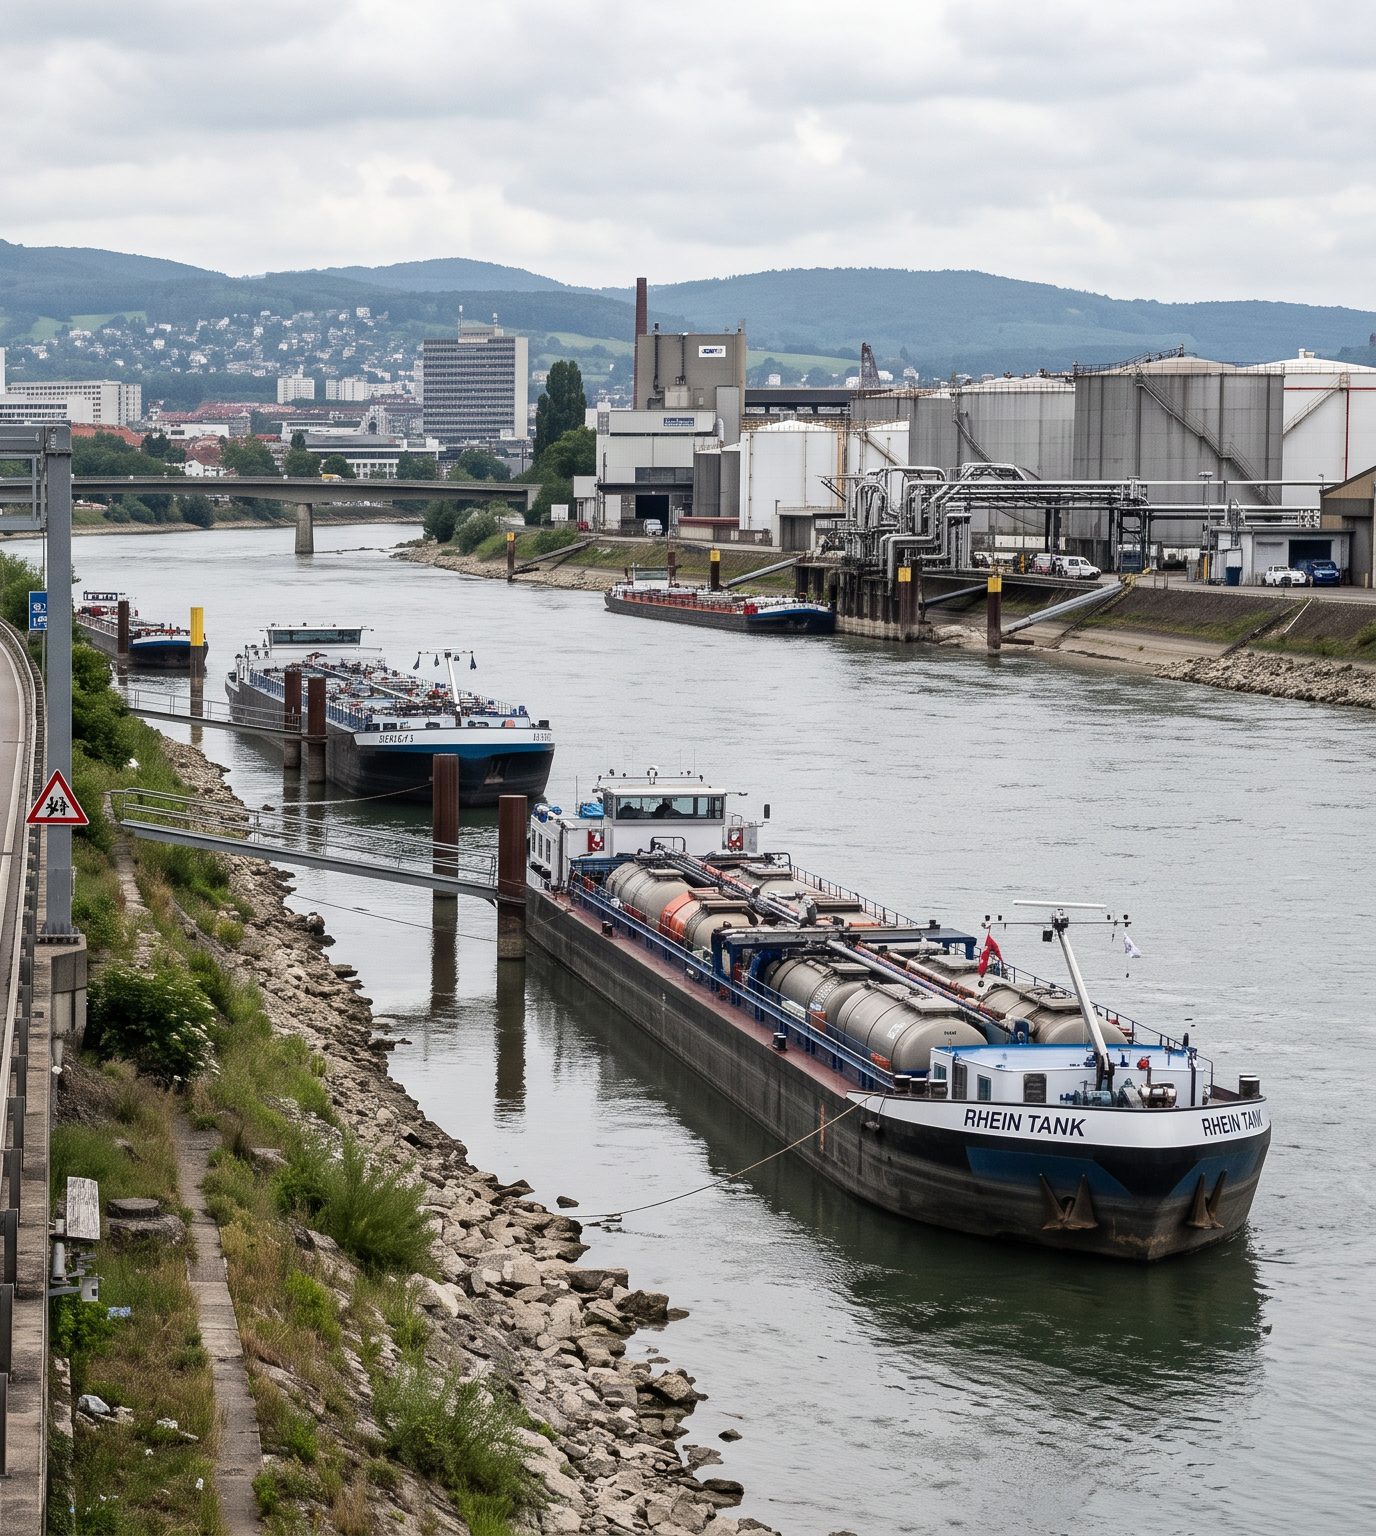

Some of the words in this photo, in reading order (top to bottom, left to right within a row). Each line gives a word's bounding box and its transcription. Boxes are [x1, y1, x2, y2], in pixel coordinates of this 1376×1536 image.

[964, 1108, 1022, 1132] RHEIN
[1028, 1114, 1087, 1137] TANK
[1201, 1113, 1241, 1137] RHEIN
[1241, 1109, 1263, 1130] TANK
